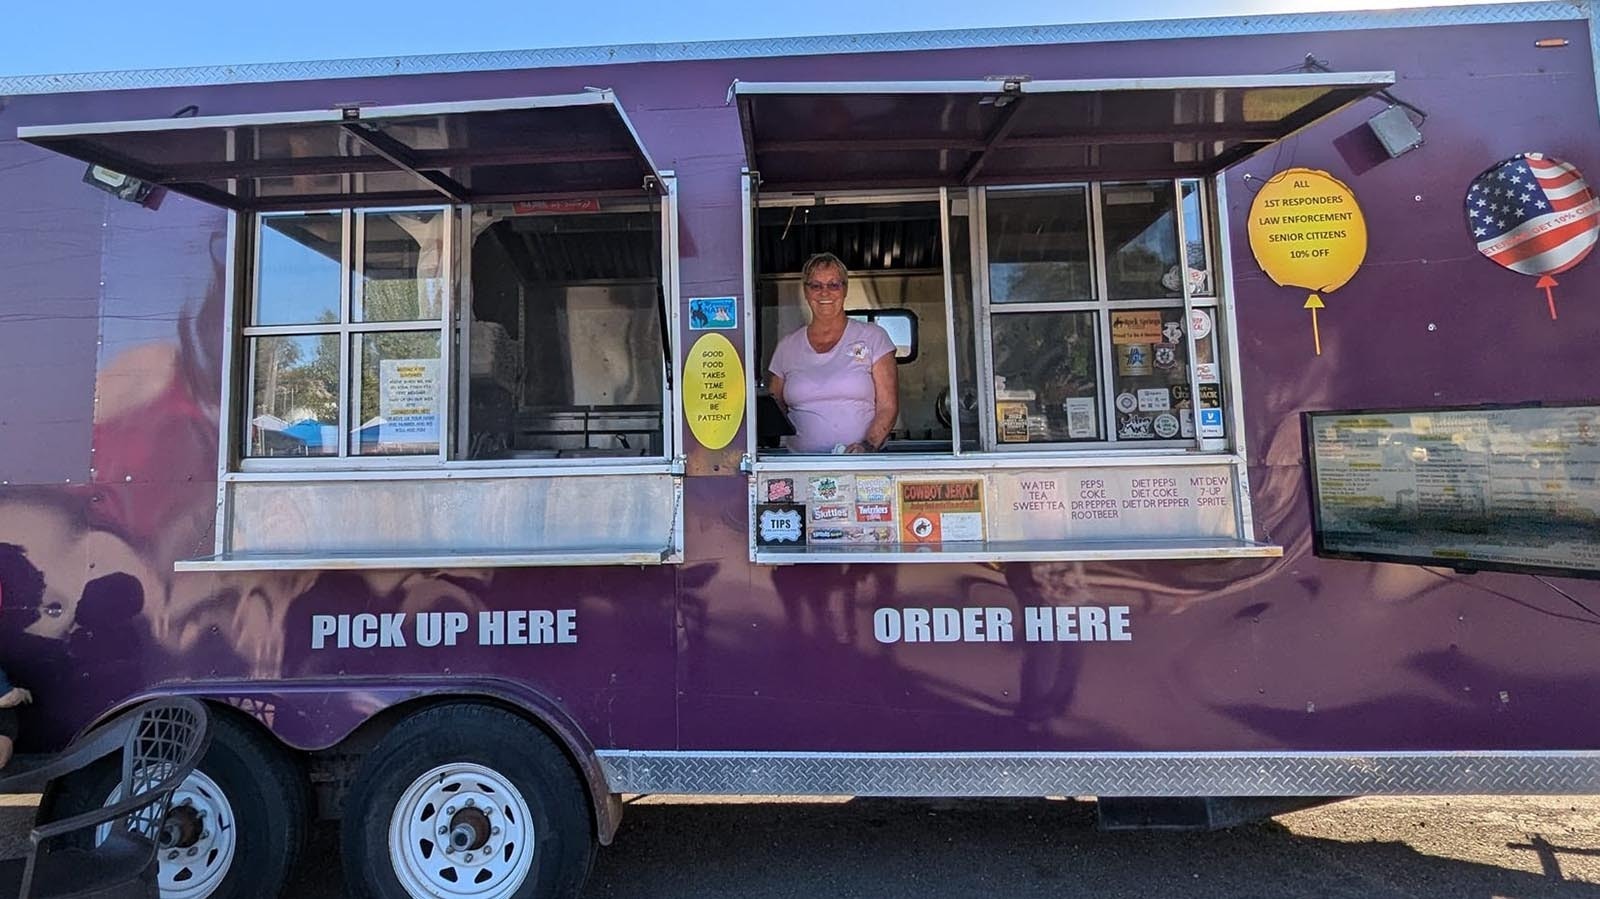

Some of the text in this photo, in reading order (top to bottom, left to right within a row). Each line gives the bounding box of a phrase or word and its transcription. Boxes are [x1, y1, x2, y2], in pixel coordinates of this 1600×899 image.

[1294, 180, 1311, 189] ALL
[1264, 195, 1343, 208] 1ST RESPONDERS
[1259, 212, 1353, 226] LAW ENFORCEMENT
[1553, 213, 1576, 225] 10%
[1269, 230, 1347, 243] SENIOR CITIZENS
[1290, 248, 1330, 259] 10% OFF
[702, 350, 724, 358] GOOD
[701, 371, 726, 379] TAKES
[700, 392, 728, 400] PLEASE
[697, 414, 732, 422] PATIENT
[1020, 481, 1056, 490] WATER
[1080, 480, 1105, 489] PEPSI
[1132, 478, 1177, 488] DIET PEPSI
[1190, 476, 1229, 487] MT DEW
[904, 483, 975, 500] COWBOY JERKY
[1030, 491, 1048, 500] TEA
[1080, 490, 1106, 499] COKE
[1131, 488, 1178, 498] DIET COKE
[1200, 487, 1221, 496] 7-UP
[1013, 501, 1066, 511] SWEET TEA
[1071, 499, 1117, 509] DR PEPPER
[1122, 498, 1190, 509] DIET DR PEPPER
[1197, 497, 1227, 507] SPRITE
[814, 507, 848, 520] Skittles
[1071, 510, 1119, 520] ROOTBEER
[770, 519, 791, 529] TIPS
[311, 609, 578, 649] PICK UP HERE
[873, 605, 1132, 643] ORDER HERE
